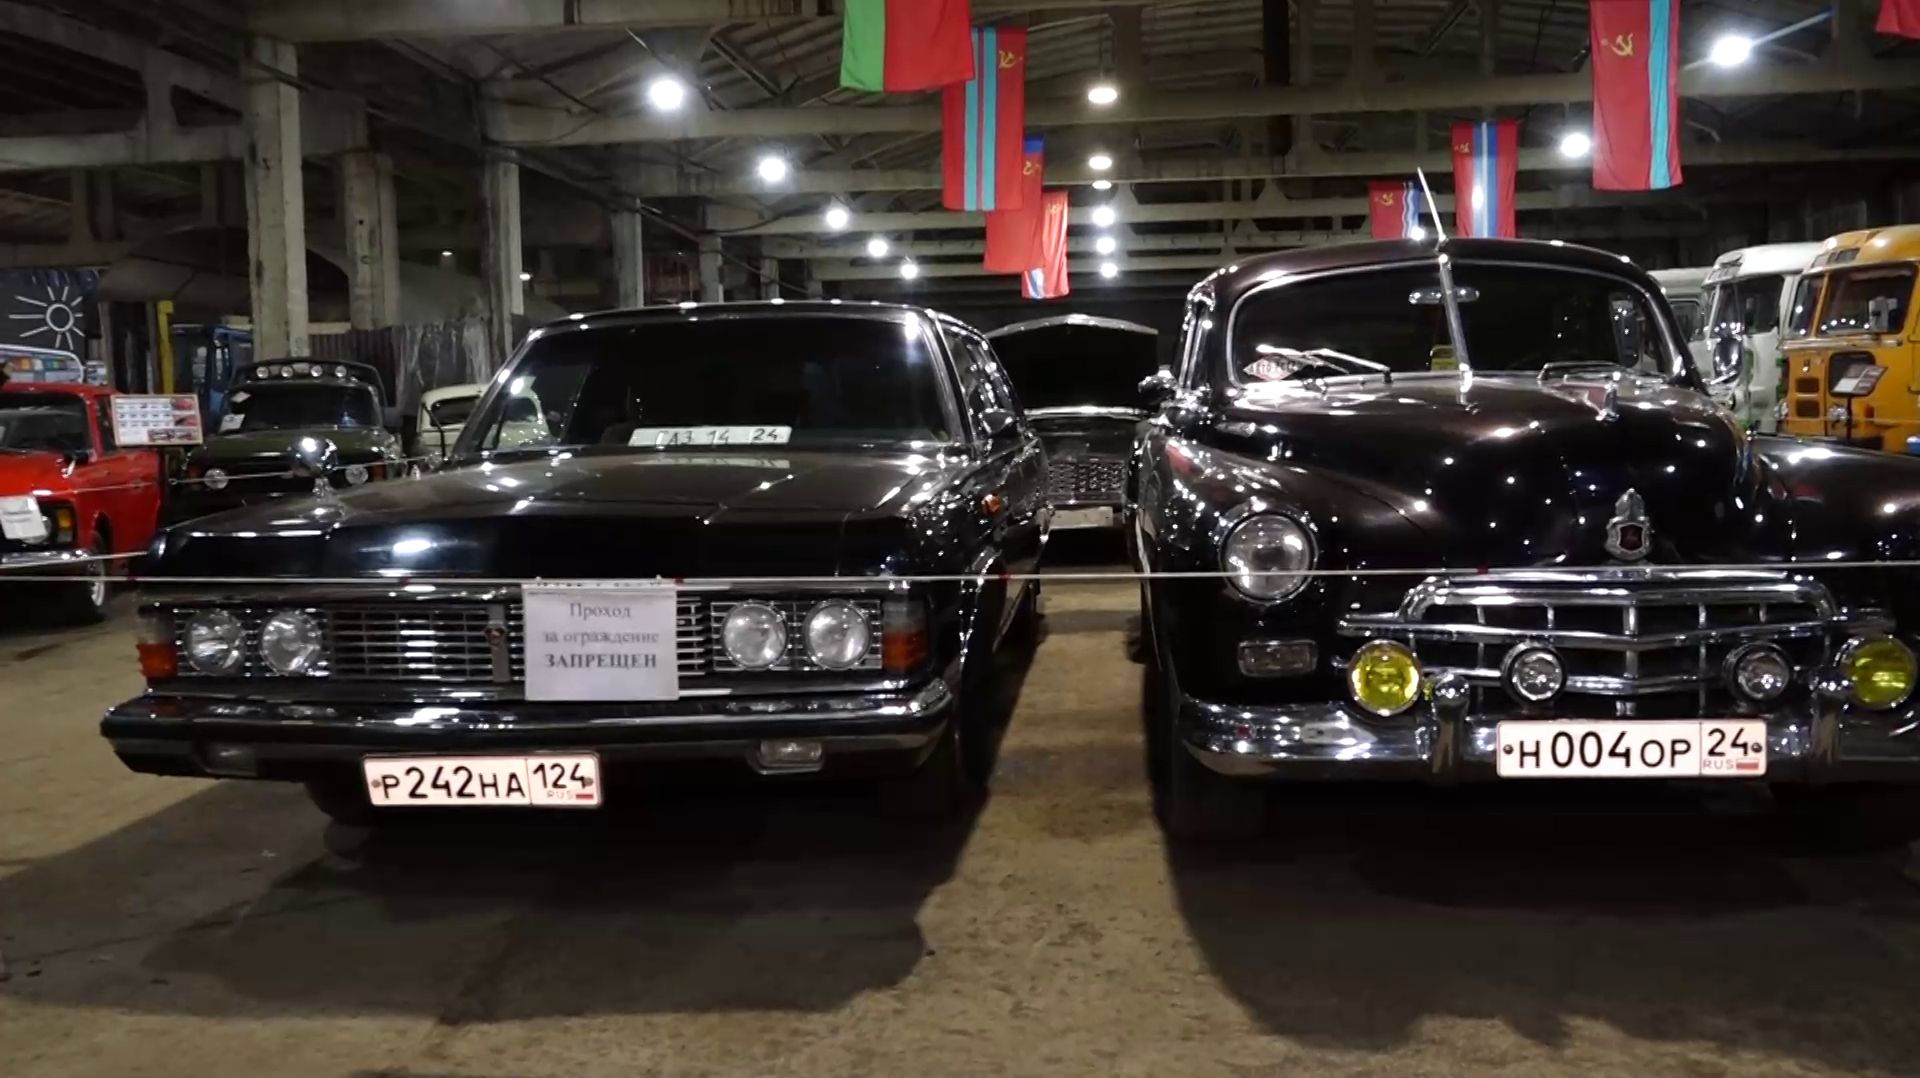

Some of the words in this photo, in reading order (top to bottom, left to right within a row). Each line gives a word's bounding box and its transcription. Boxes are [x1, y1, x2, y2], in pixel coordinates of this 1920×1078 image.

[752, 428, 778, 441] 24
[569, 602, 631, 620] Проход
[563, 632, 660, 647] ограждение
[545, 653, 657, 670] ЗАПРЕЩЕН
[1518, 731, 1692, 769] Н004ОР
[1707, 728, 1749, 757] 24
[1702, 759, 1735, 770] RUS
[381, 766, 526, 799] Р242НА
[533, 763, 588, 789] 124
[547, 790, 574, 800] RUS
